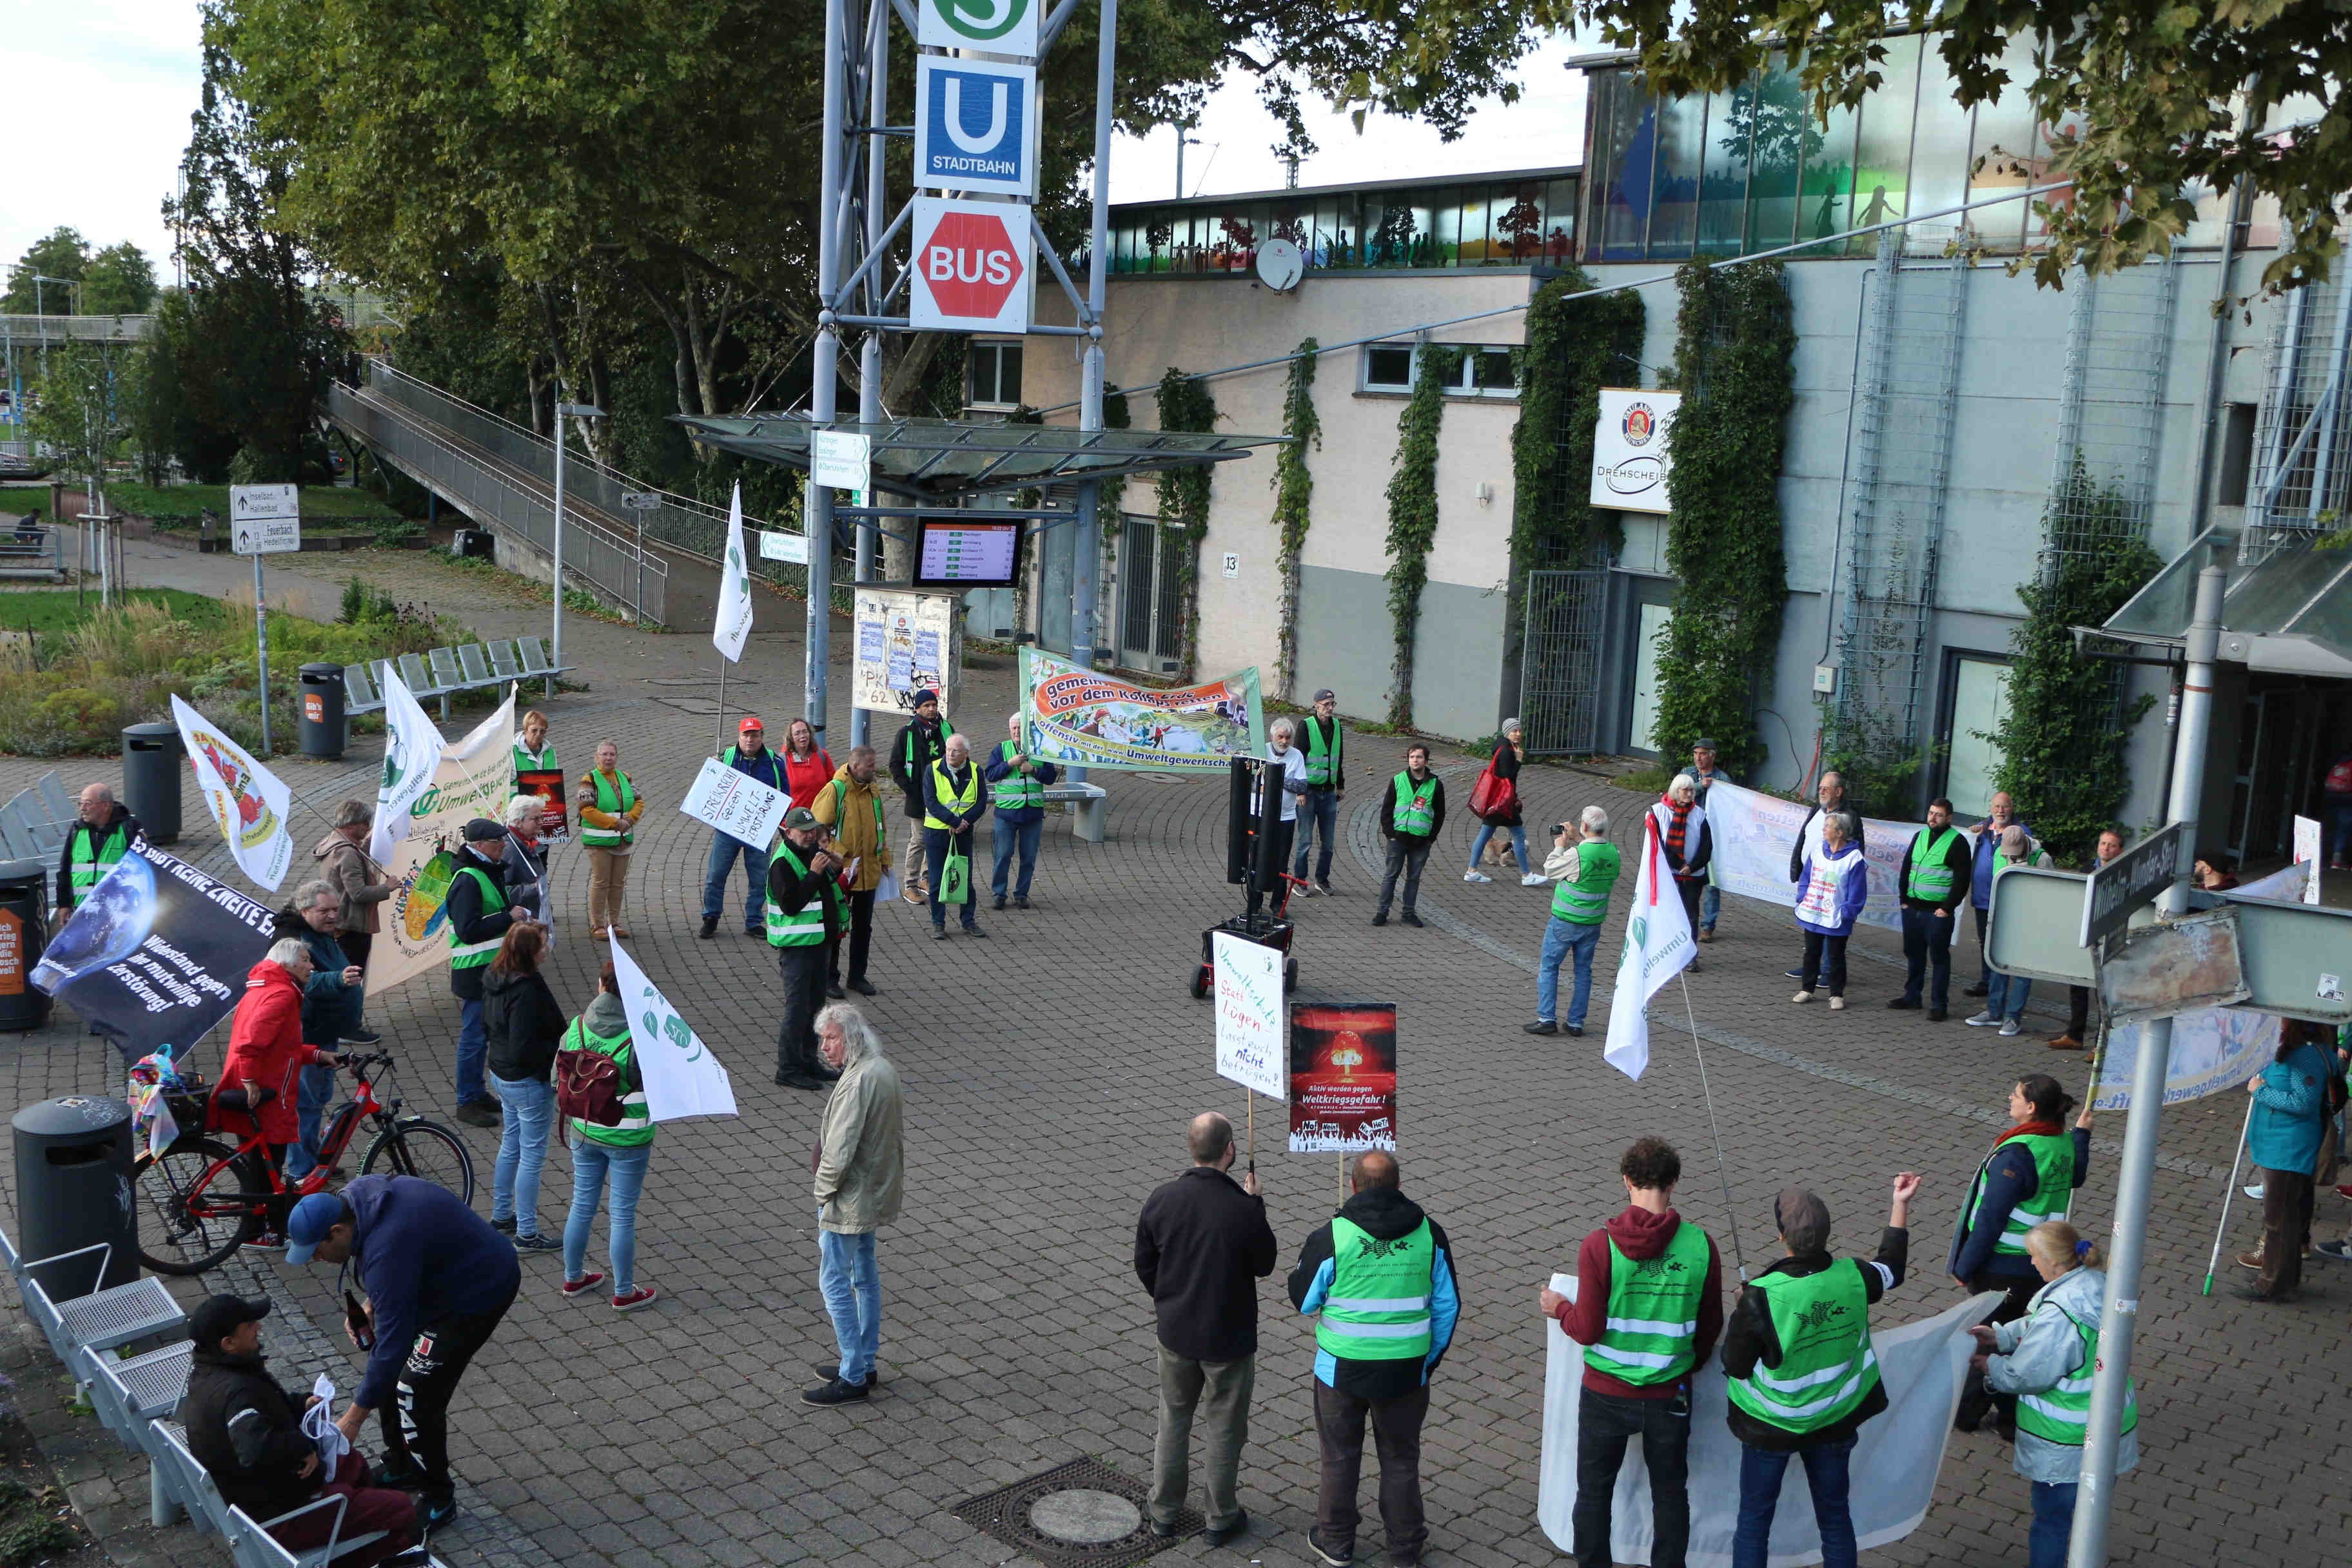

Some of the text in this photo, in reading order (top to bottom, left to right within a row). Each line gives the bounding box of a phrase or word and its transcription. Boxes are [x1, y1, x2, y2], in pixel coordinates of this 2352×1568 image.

[945, 77, 1008, 154] U
[933, 155, 1015, 175] STADTBAHN
[928, 246, 1012, 285] BUS
[1623, 402, 1655, 420] PAULANER
[1598, 467, 1666, 481] DREHSCHEIB
[1228, 557, 1235, 570] 13
[1050, 693, 1077, 710] vor
[1082, 688, 1115, 701] dem
[1038, 719, 1079, 744] offensiv
[1081, 740, 1092, 749] mit
[106, 963, 175, 1013] Zerstörung!
[1235, 1048, 1264, 1068] nicht
[1302, 1094, 1380, 1105] Weltkriegsgefahr
[1304, 1121, 1317, 1130] No!
